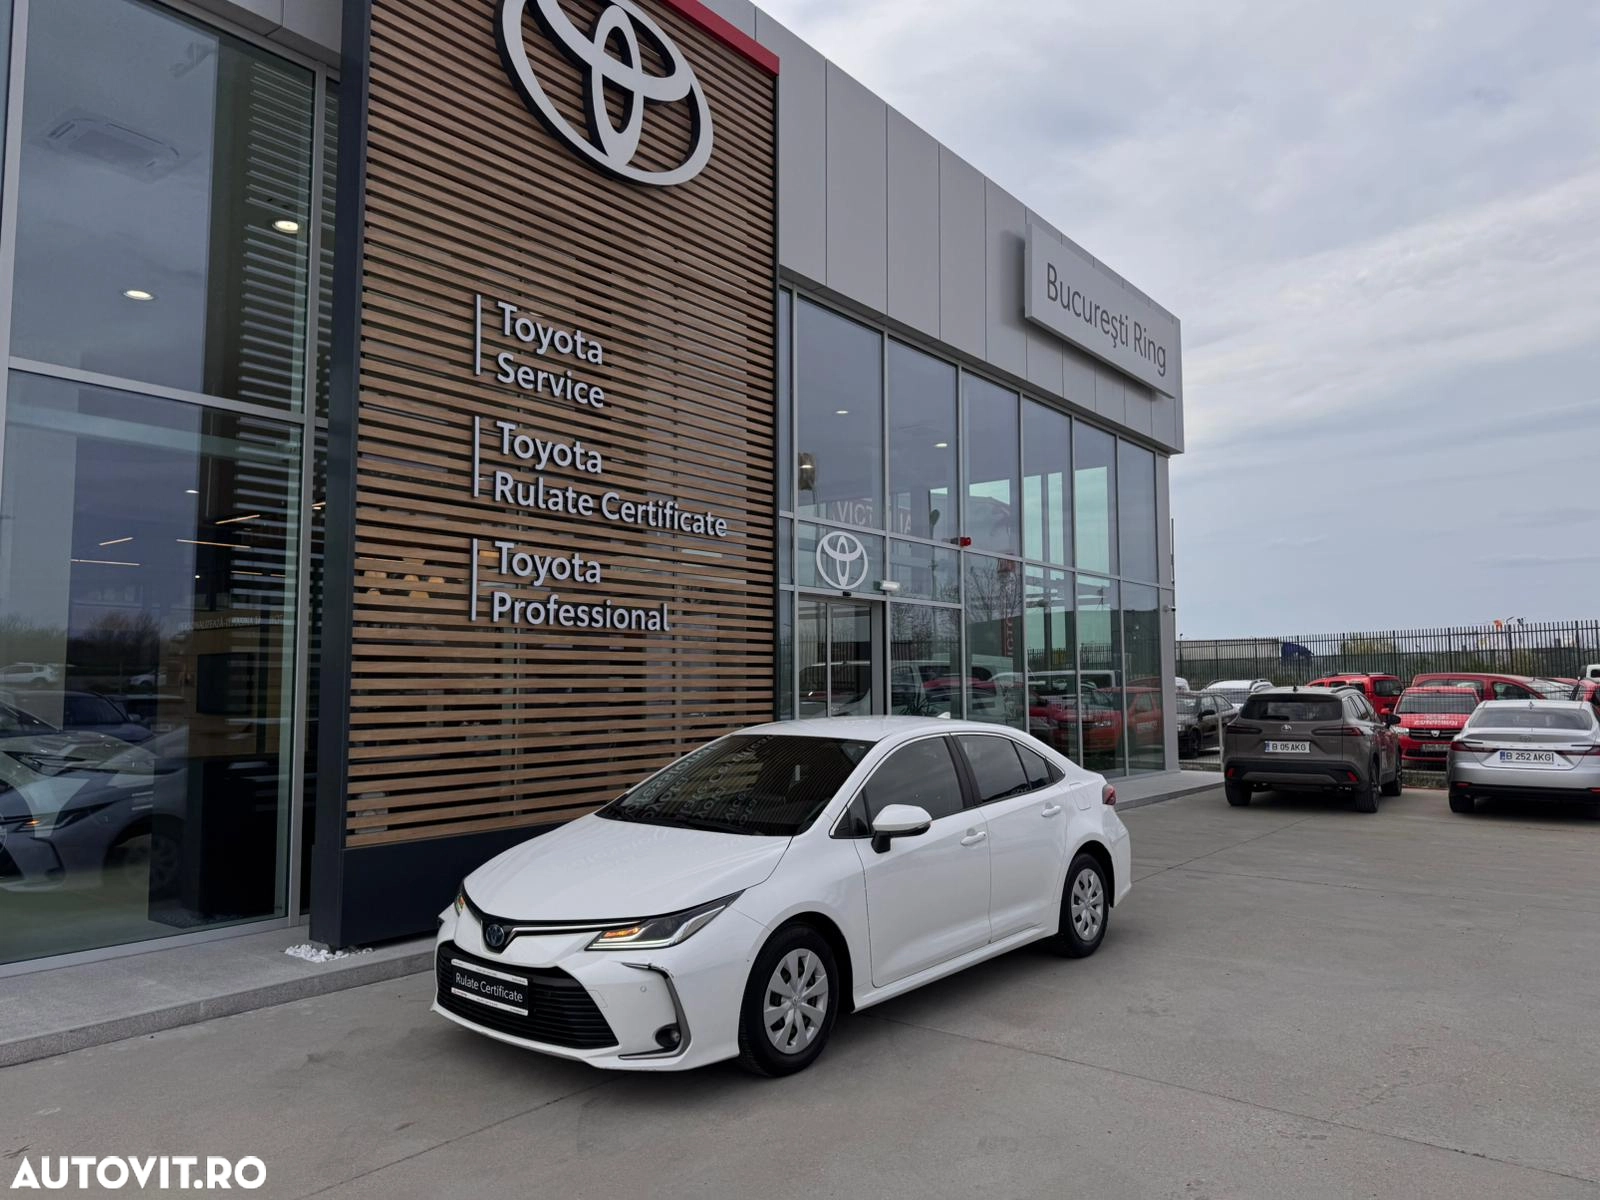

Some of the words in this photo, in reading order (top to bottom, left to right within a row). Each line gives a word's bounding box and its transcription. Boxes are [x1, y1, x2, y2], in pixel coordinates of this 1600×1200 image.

[497, 301, 603, 365] Toyota
[1134, 321, 1166, 377] Ring
[497, 352, 605, 408] Service
[496, 420, 602, 474] Toyota
[494, 470, 594, 517] Rulate
[601, 492, 728, 537] Certificate
[495, 540, 601, 587] Toyota
[492, 591, 670, 632] Professional
[1515, 752, 1531, 761] 252
[1533, 753, 1551, 761] AKG
[455, 972, 479, 990] Rulate
[480, 981, 523, 1003] Certificate
